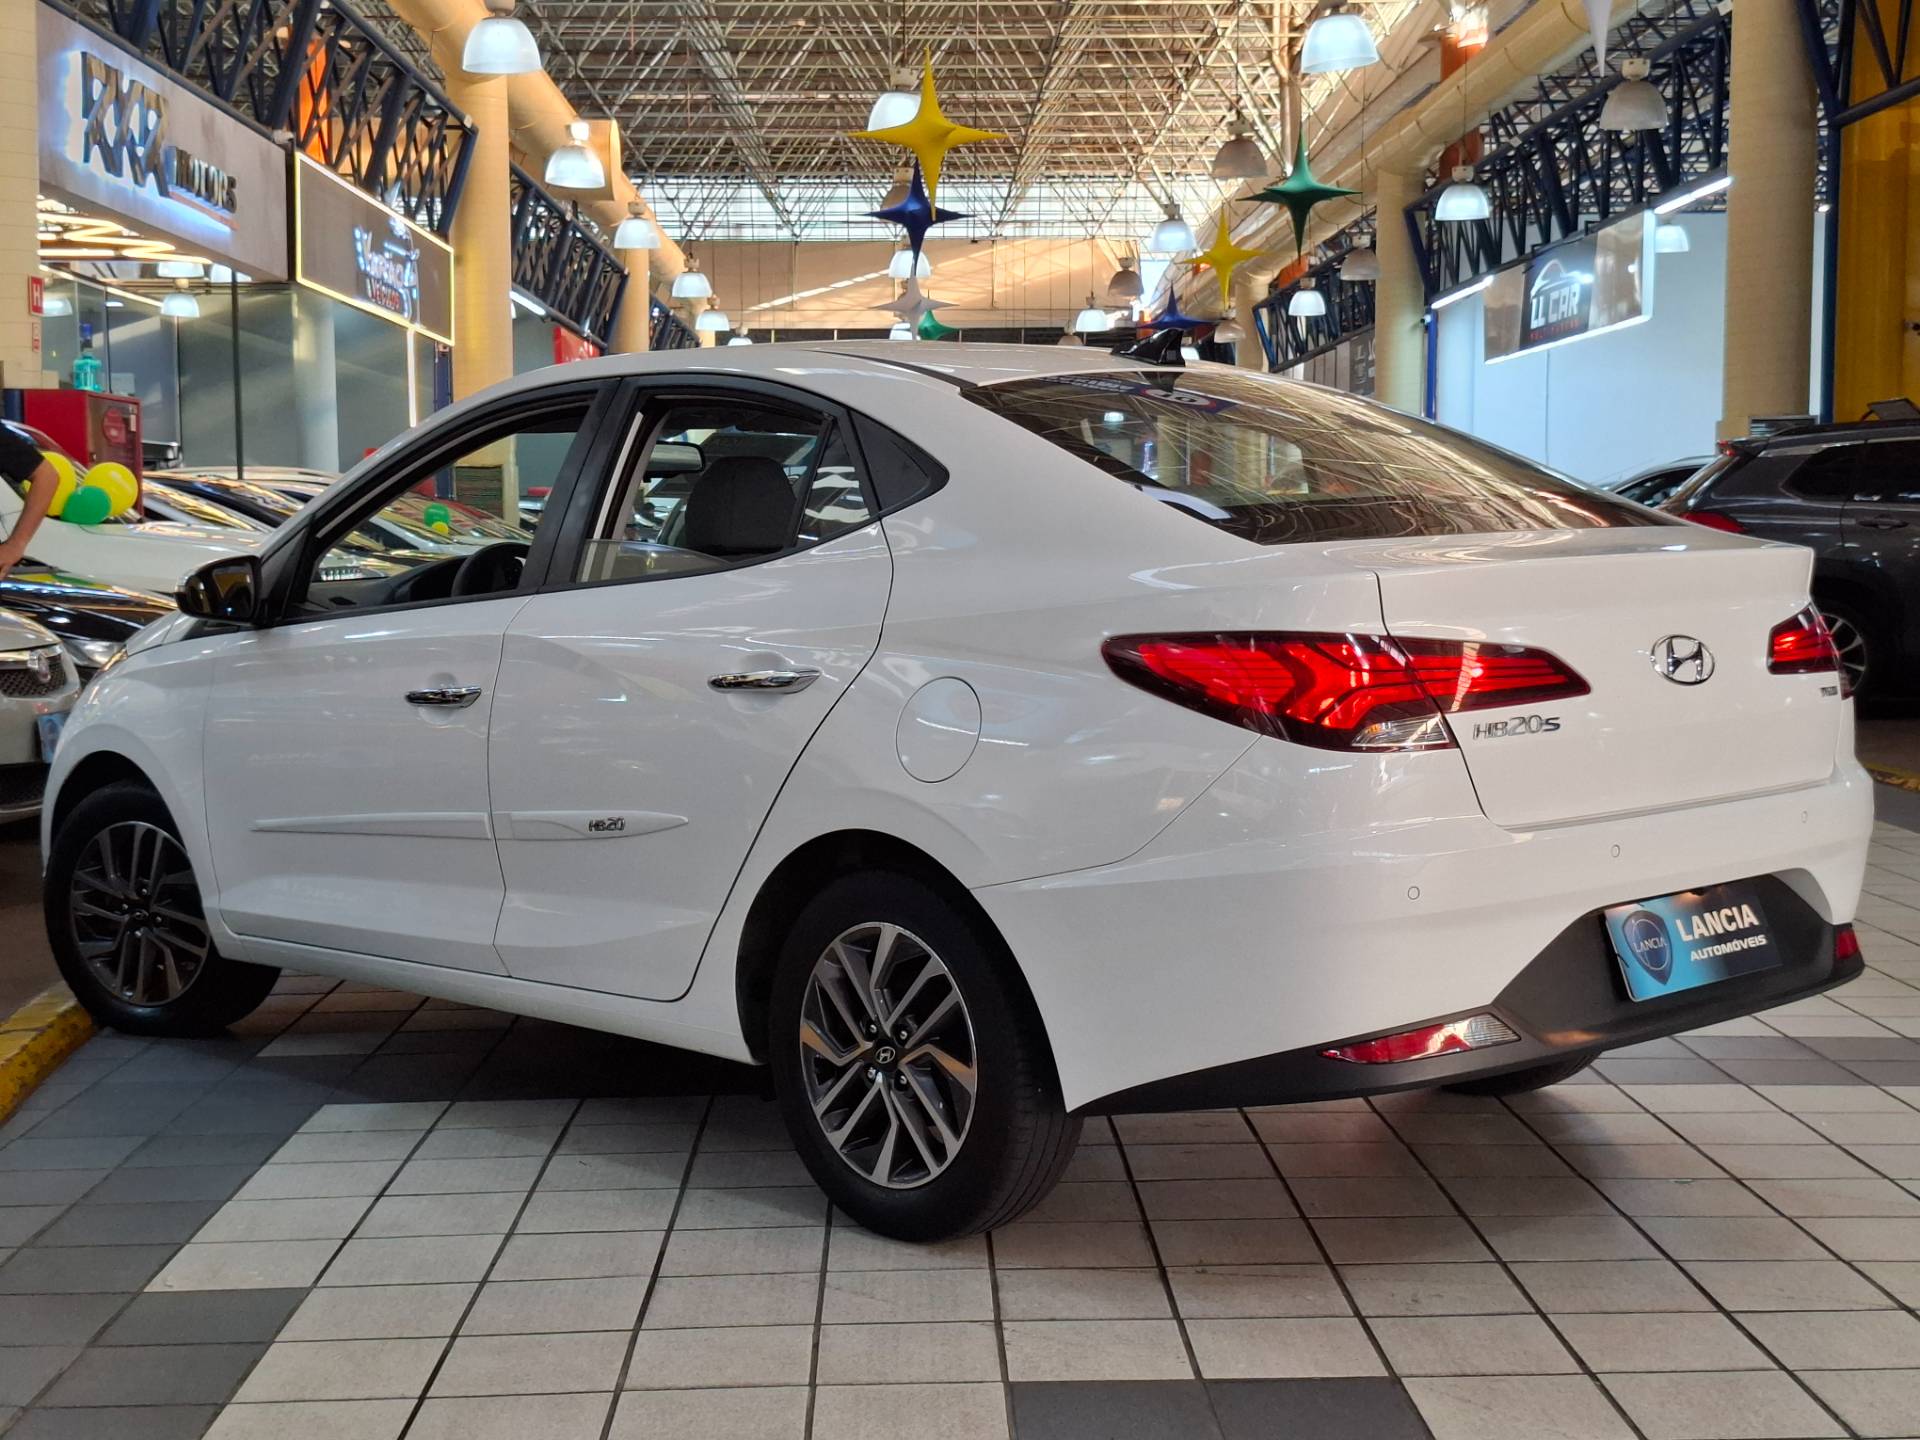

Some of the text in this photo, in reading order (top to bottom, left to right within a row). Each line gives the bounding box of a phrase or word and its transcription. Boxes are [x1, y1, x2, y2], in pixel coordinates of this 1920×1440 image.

[164, 147, 237, 213] MOTORS
[33, 284, 41, 307] H
[1548, 284, 1580, 323] CAR
[1676, 904, 1759, 942] LANCIA
[1634, 936, 1668, 953] LANCIA
[1690, 934, 1768, 961] AUTOMÓVEIS
